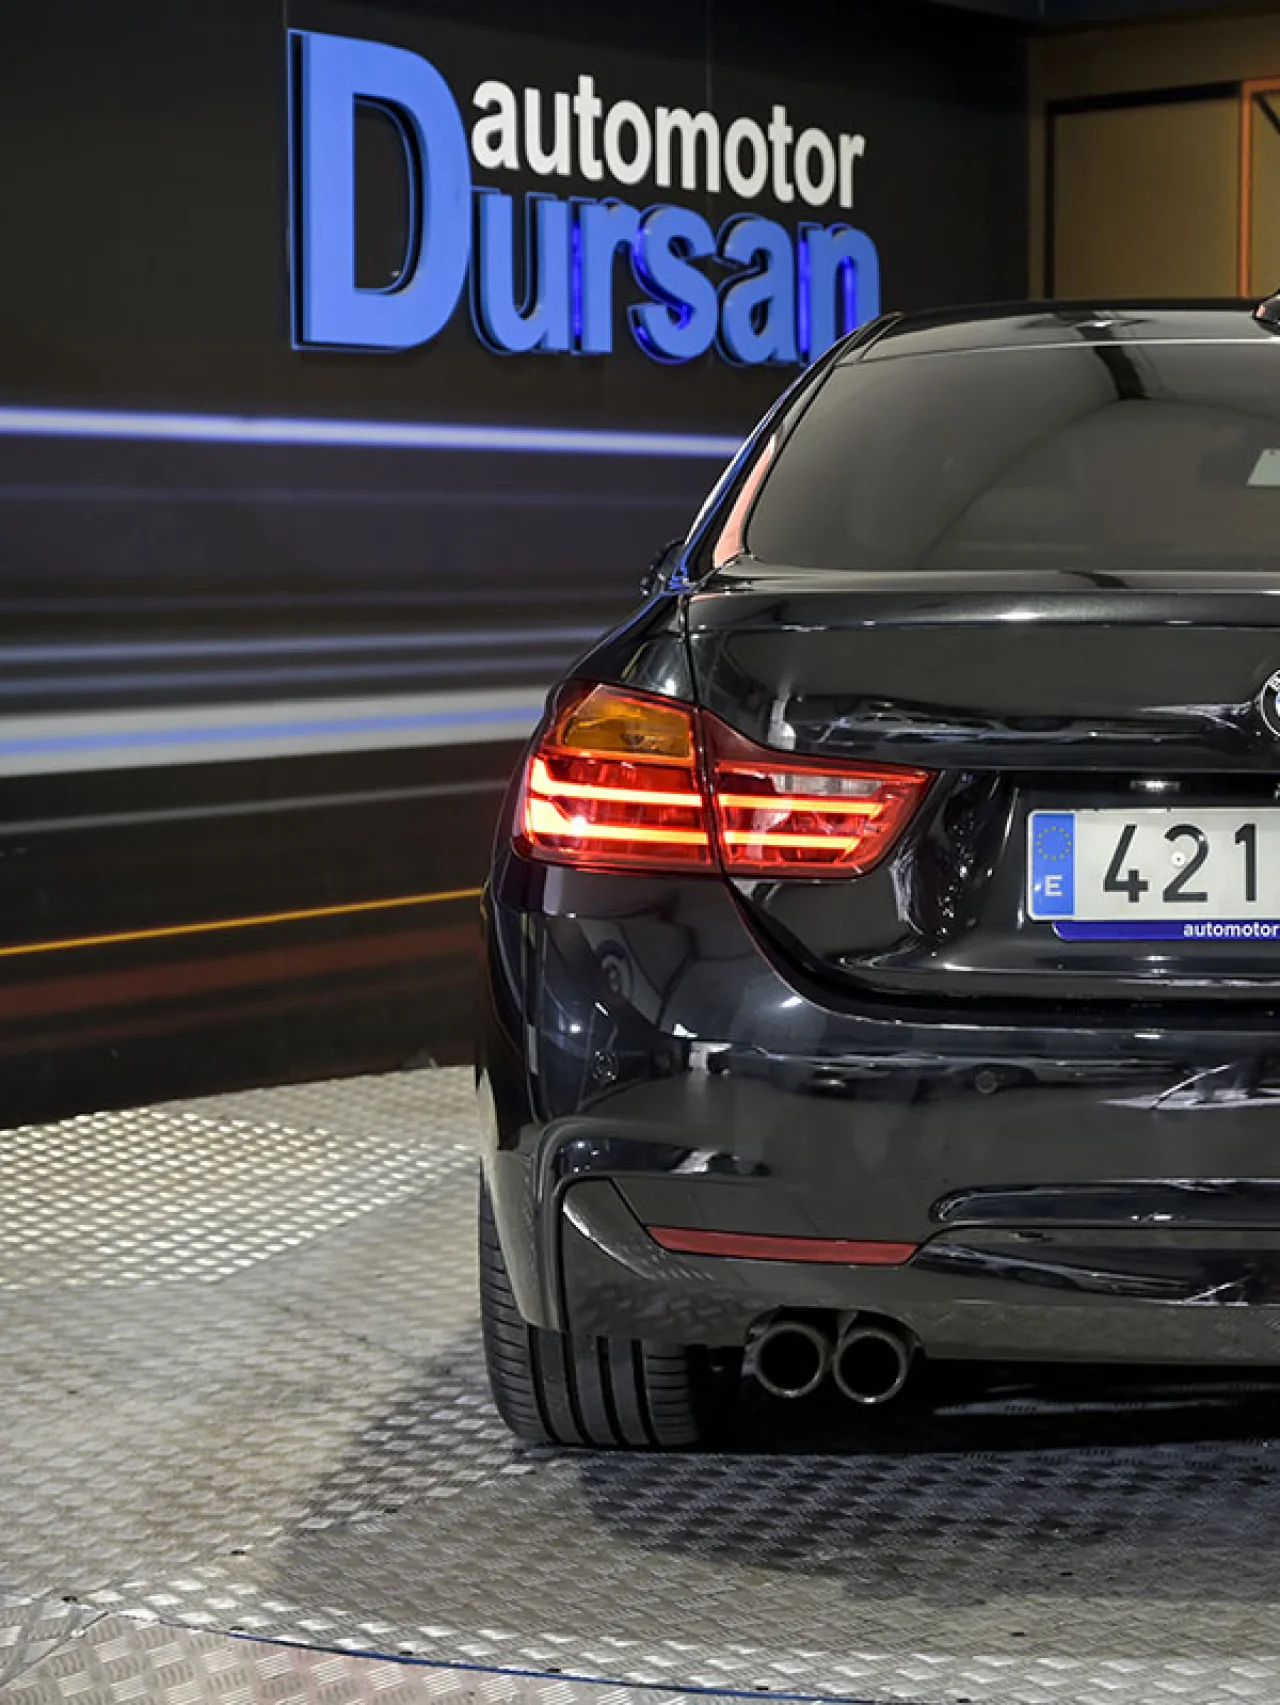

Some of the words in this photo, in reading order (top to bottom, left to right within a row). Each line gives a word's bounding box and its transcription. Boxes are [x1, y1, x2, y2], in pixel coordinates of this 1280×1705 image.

[471, 74, 866, 209] automotor
[287, 27, 881, 367] Dursan
[1044, 874, 1064, 897] E
[1183, 922, 1280, 938] automotor
